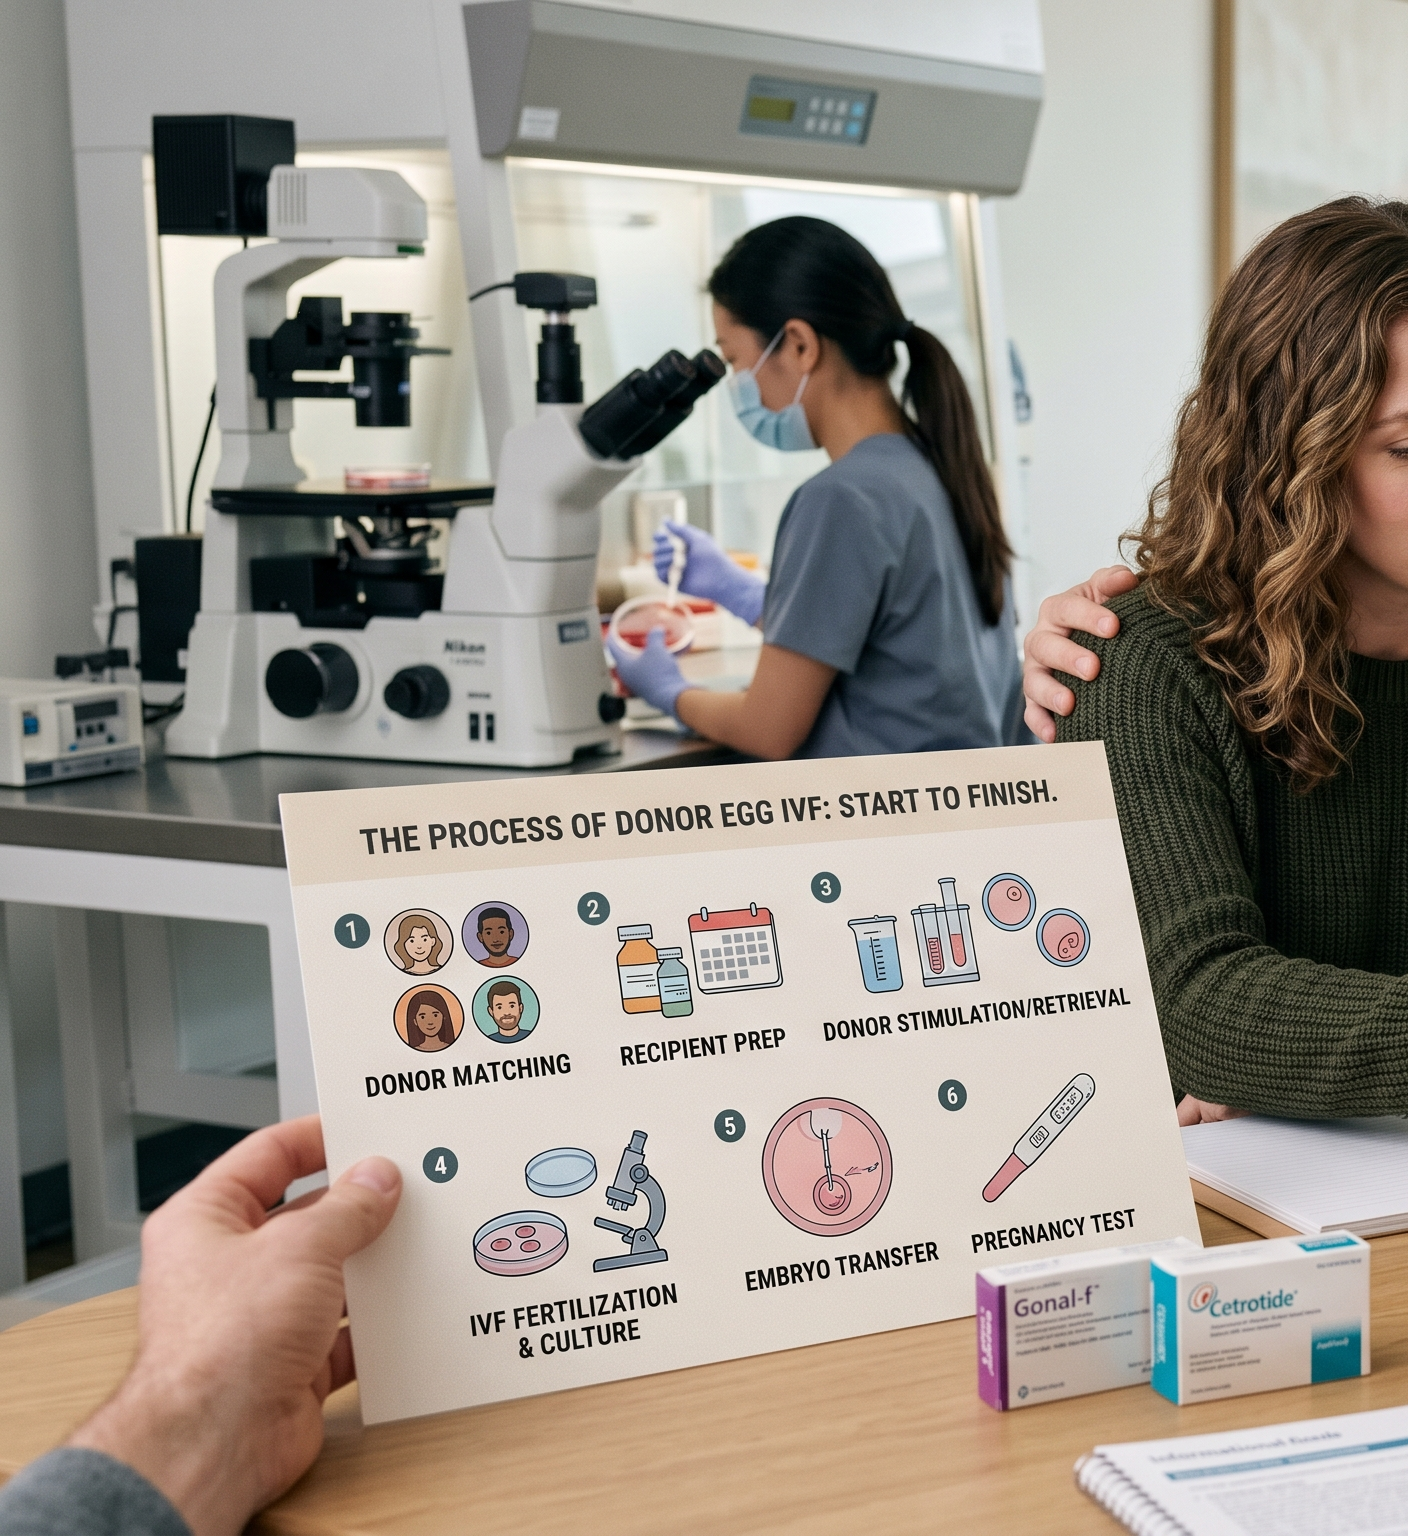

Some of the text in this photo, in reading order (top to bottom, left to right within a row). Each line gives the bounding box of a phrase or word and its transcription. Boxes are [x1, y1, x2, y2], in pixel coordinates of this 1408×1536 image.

[445, 640, 486, 653] Nikon
[360, 779, 1058, 855] THE PROCESS OF DONOR EGG IVF: START TO FINISH.
[819, 878, 832, 897] 3
[587, 899, 601, 918] 2
[345, 921, 357, 941] 1
[823, 987, 1131, 1042] DONOR STIMULATION/RETRIEVAL
[620, 1027, 786, 1067] RECIPIENT PREP
[365, 1053, 571, 1098] DONOR MATCHING
[947, 1086, 958, 1105] 6
[724, 1116, 736, 1136] 5
[434, 1155, 447, 1175] 4
[971, 1208, 1135, 1254] PREGNANCY TEST
[744, 1241, 940, 1292] EMBRYO TRANSFER
[469, 1282, 678, 1337] IVF FERTILIZATION
[518, 1318, 641, 1359] & CULTURE
